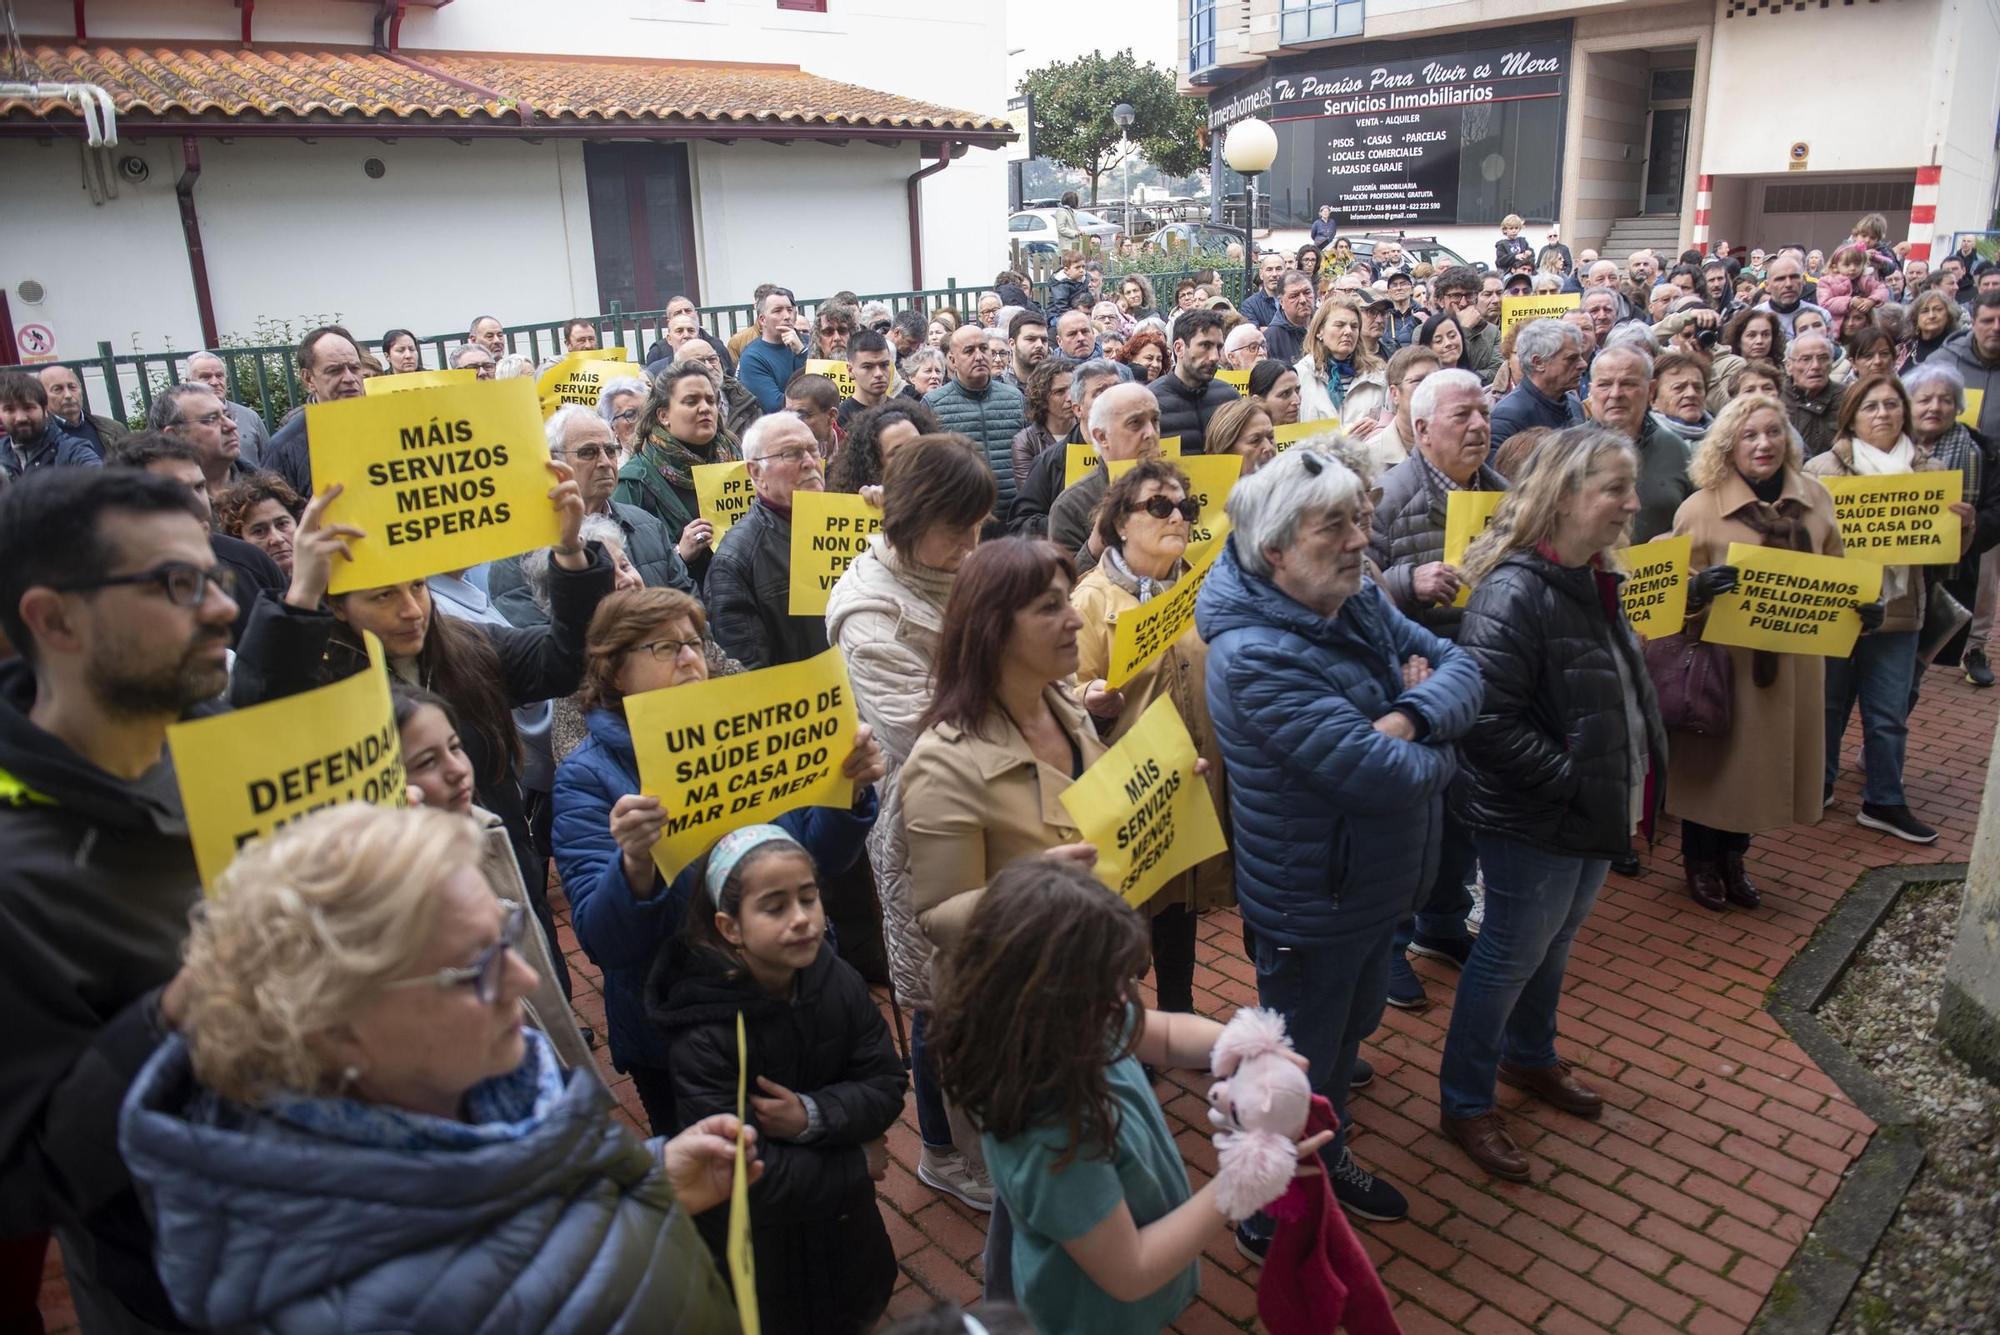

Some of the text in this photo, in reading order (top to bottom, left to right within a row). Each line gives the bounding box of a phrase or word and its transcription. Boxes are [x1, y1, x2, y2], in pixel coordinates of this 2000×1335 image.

[1275, 51, 1560, 100] Tu Paraíso Para Vivir es Mera
[1324, 84, 1493, 116] Servicios Inmobiliarios
[1356, 117, 1379, 127] VENTA
[1385, 114, 1420, 125] ALQUILER
[1332, 131, 1446, 148] PISOS CASAS PARCELAS
[1332, 147, 1423, 161] LOCALES COMERCIALES
[1332, 162, 1403, 175] PLAZAS DE GARAJE
[1352, 182, 1417, 191] ASESORÍA INMOBILIARIA
[1370, 191, 1405, 199] PROFESIONAL
[1407, 190, 1433, 198] GRATUITA
[561, 395, 597, 406] MENO
[400, 416, 473, 450] MÁIS
[367, 444, 509, 486] SERVIZOS
[396, 476, 496, 513] MENOS
[724, 479, 753, 494] PP E
[716, 496, 743, 512] NON
[1834, 489, 1945, 505] UN CENTRO DE
[1836, 504, 1940, 519] SAÚDE DIGNO
[386, 502, 511, 546] ESPERAS
[826, 516, 850, 532] PP
[855, 518, 864, 532] E
[1842, 519, 1933, 534] NA CASA DO
[813, 535, 850, 551] NON
[1843, 534, 1942, 548] AR DE MERA
[1633, 561, 1673, 580] AMOS
[1743, 569, 1858, 595] DEFENDAMOS
[1730, 583, 1860, 609] E MELLOREMOS
[1739, 600, 1839, 622] A SANIDADE
[1135, 612, 1159, 632] UN
[1749, 615, 1819, 635] PÚBLICA
[665, 685, 843, 754] UN CENTRO DE
[676, 717, 838, 784] SAÚDE DIGNO
[248, 722, 394, 816] DEFENDA
[685, 747, 828, 807] NA CASA DO
[1124, 757, 1160, 805] MÁIS
[667, 766, 830, 837] MAR DE MERA
[1117, 770, 1181, 850] SERVIZOS
[1130, 804, 1173, 867] MENOS
